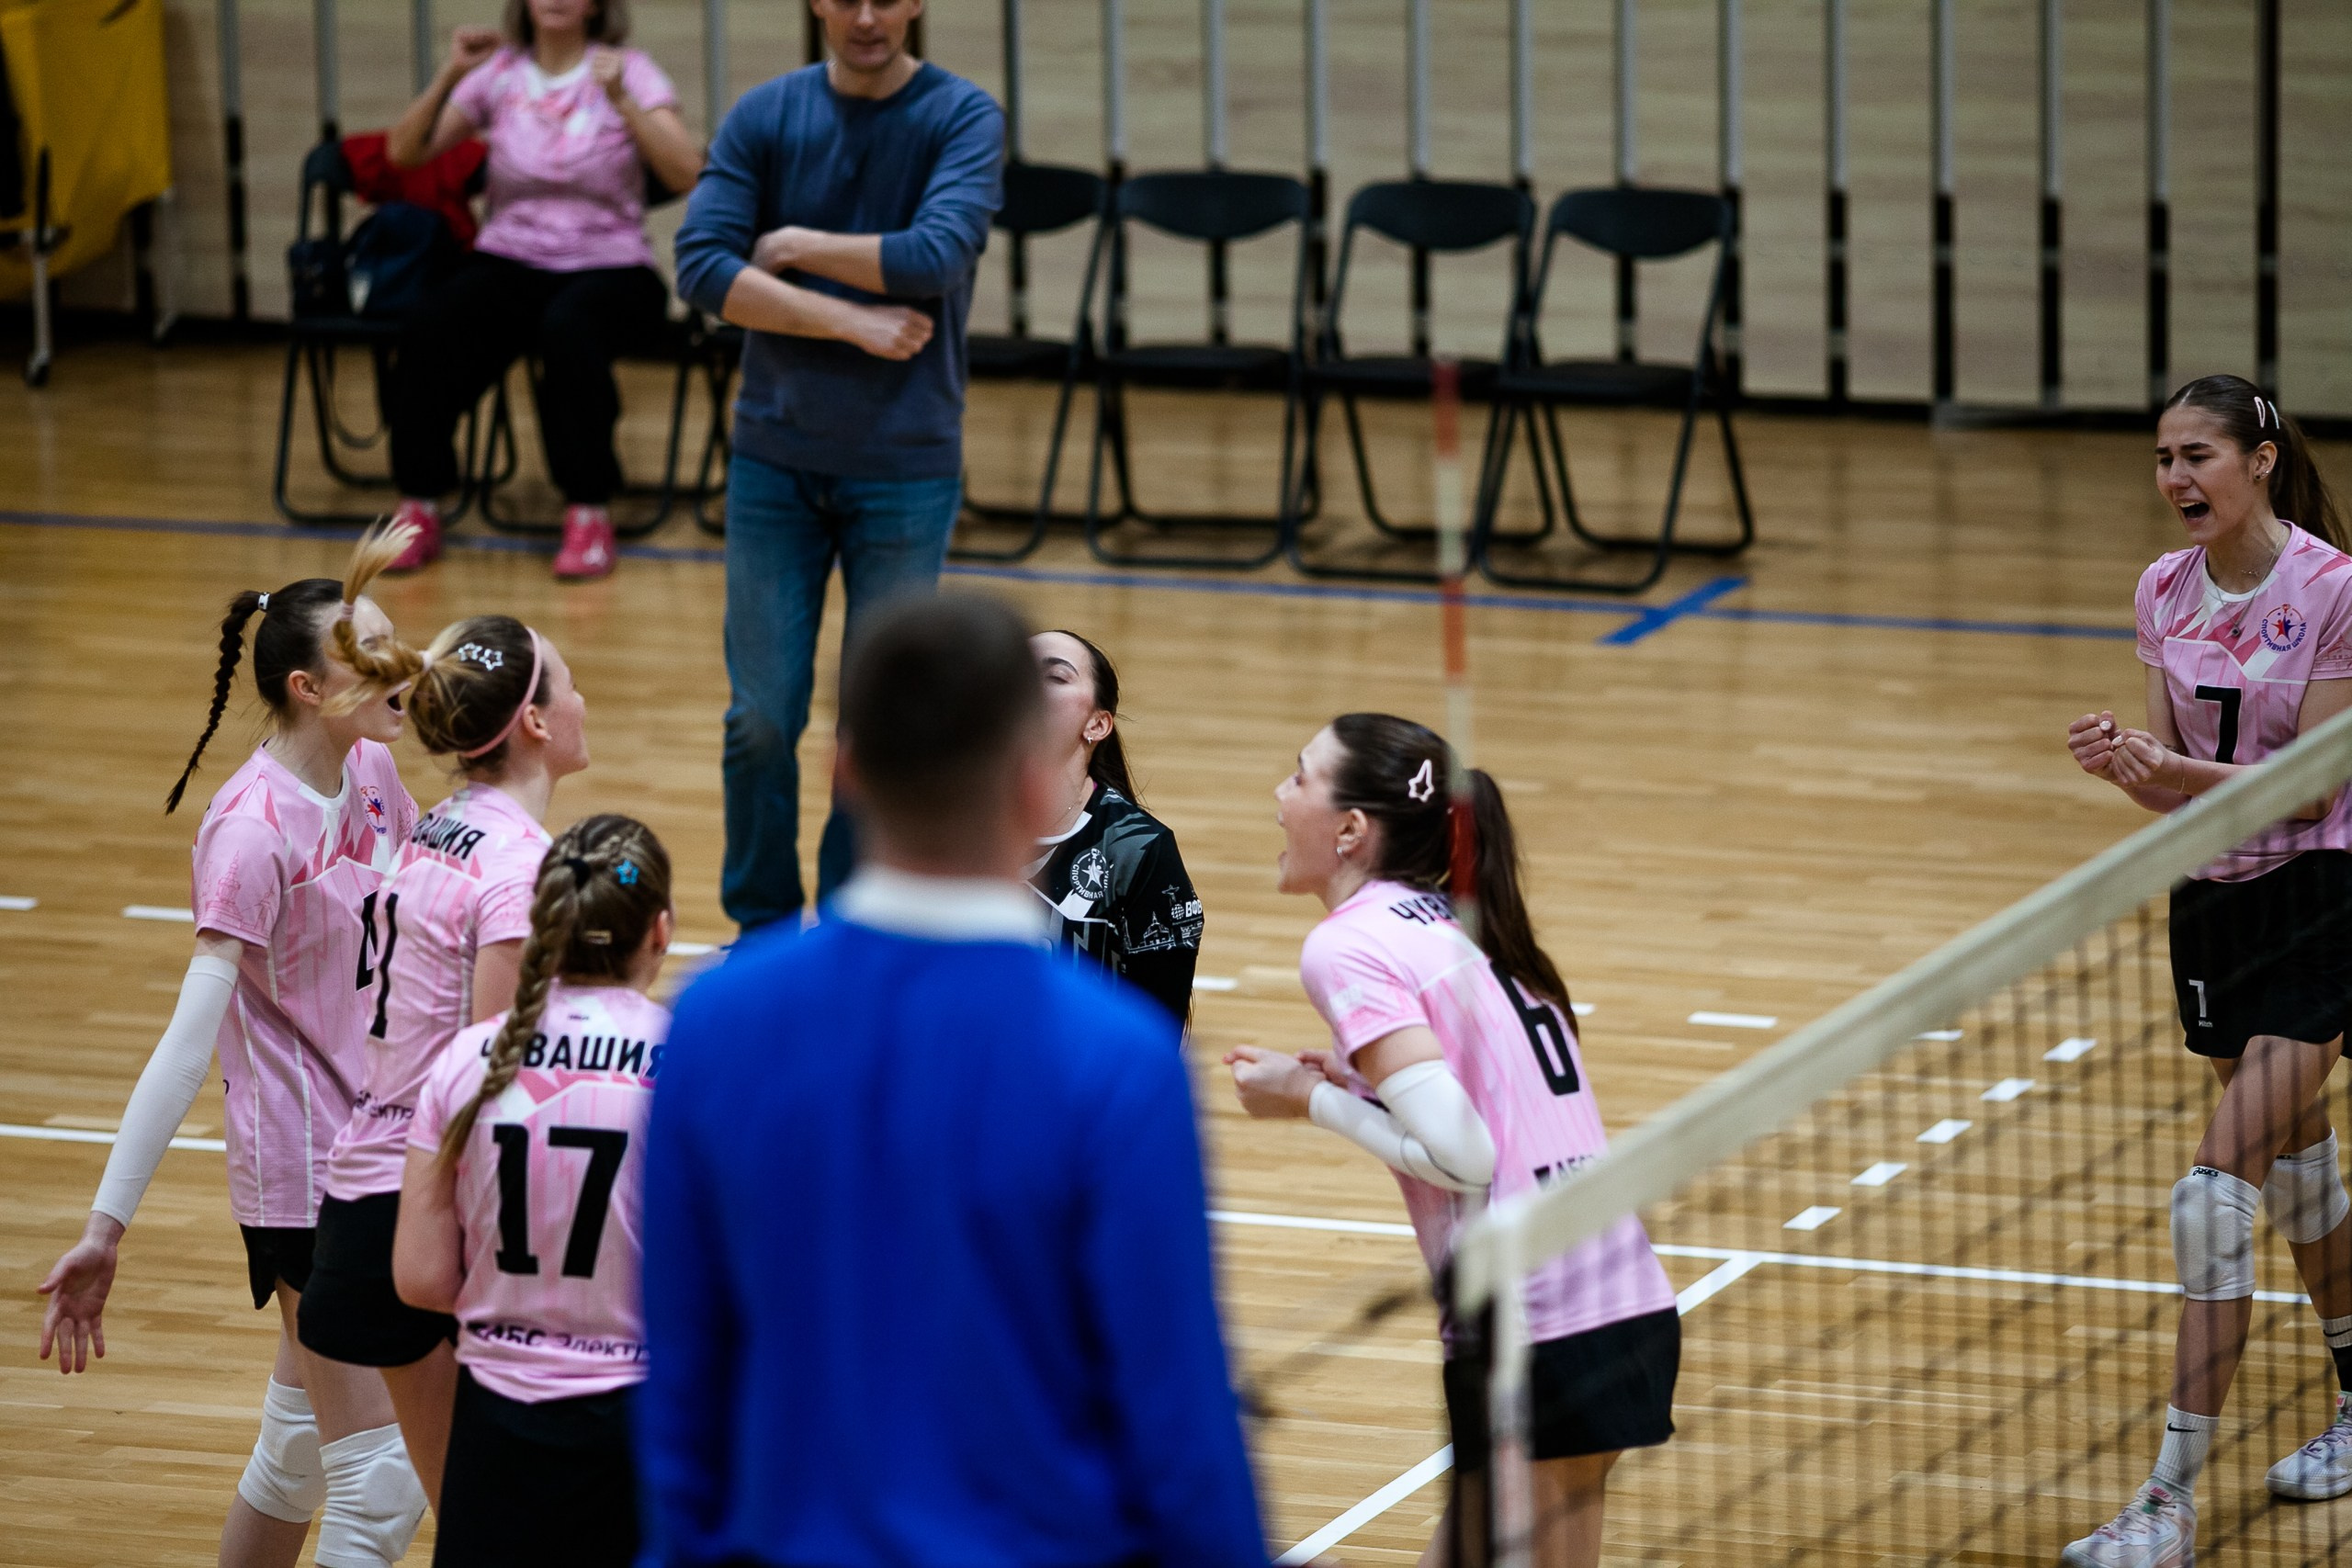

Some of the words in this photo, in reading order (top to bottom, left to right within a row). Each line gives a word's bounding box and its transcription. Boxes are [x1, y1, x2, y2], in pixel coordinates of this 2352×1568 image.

[2261, 618, 2292, 652] СПОРТИВНАЯ
[2291, 621, 2307, 649] ШКОЛА
[2194, 684, 2243, 764] 7
[1071, 863, 1104, 899] СПОРТИВНАЯ
[2188, 979, 2207, 1018] 7
[1489, 958, 1580, 1096] 6
[481, 1033, 663, 1077] ЧВАШИЯ
[492, 1123, 628, 1279] 17
